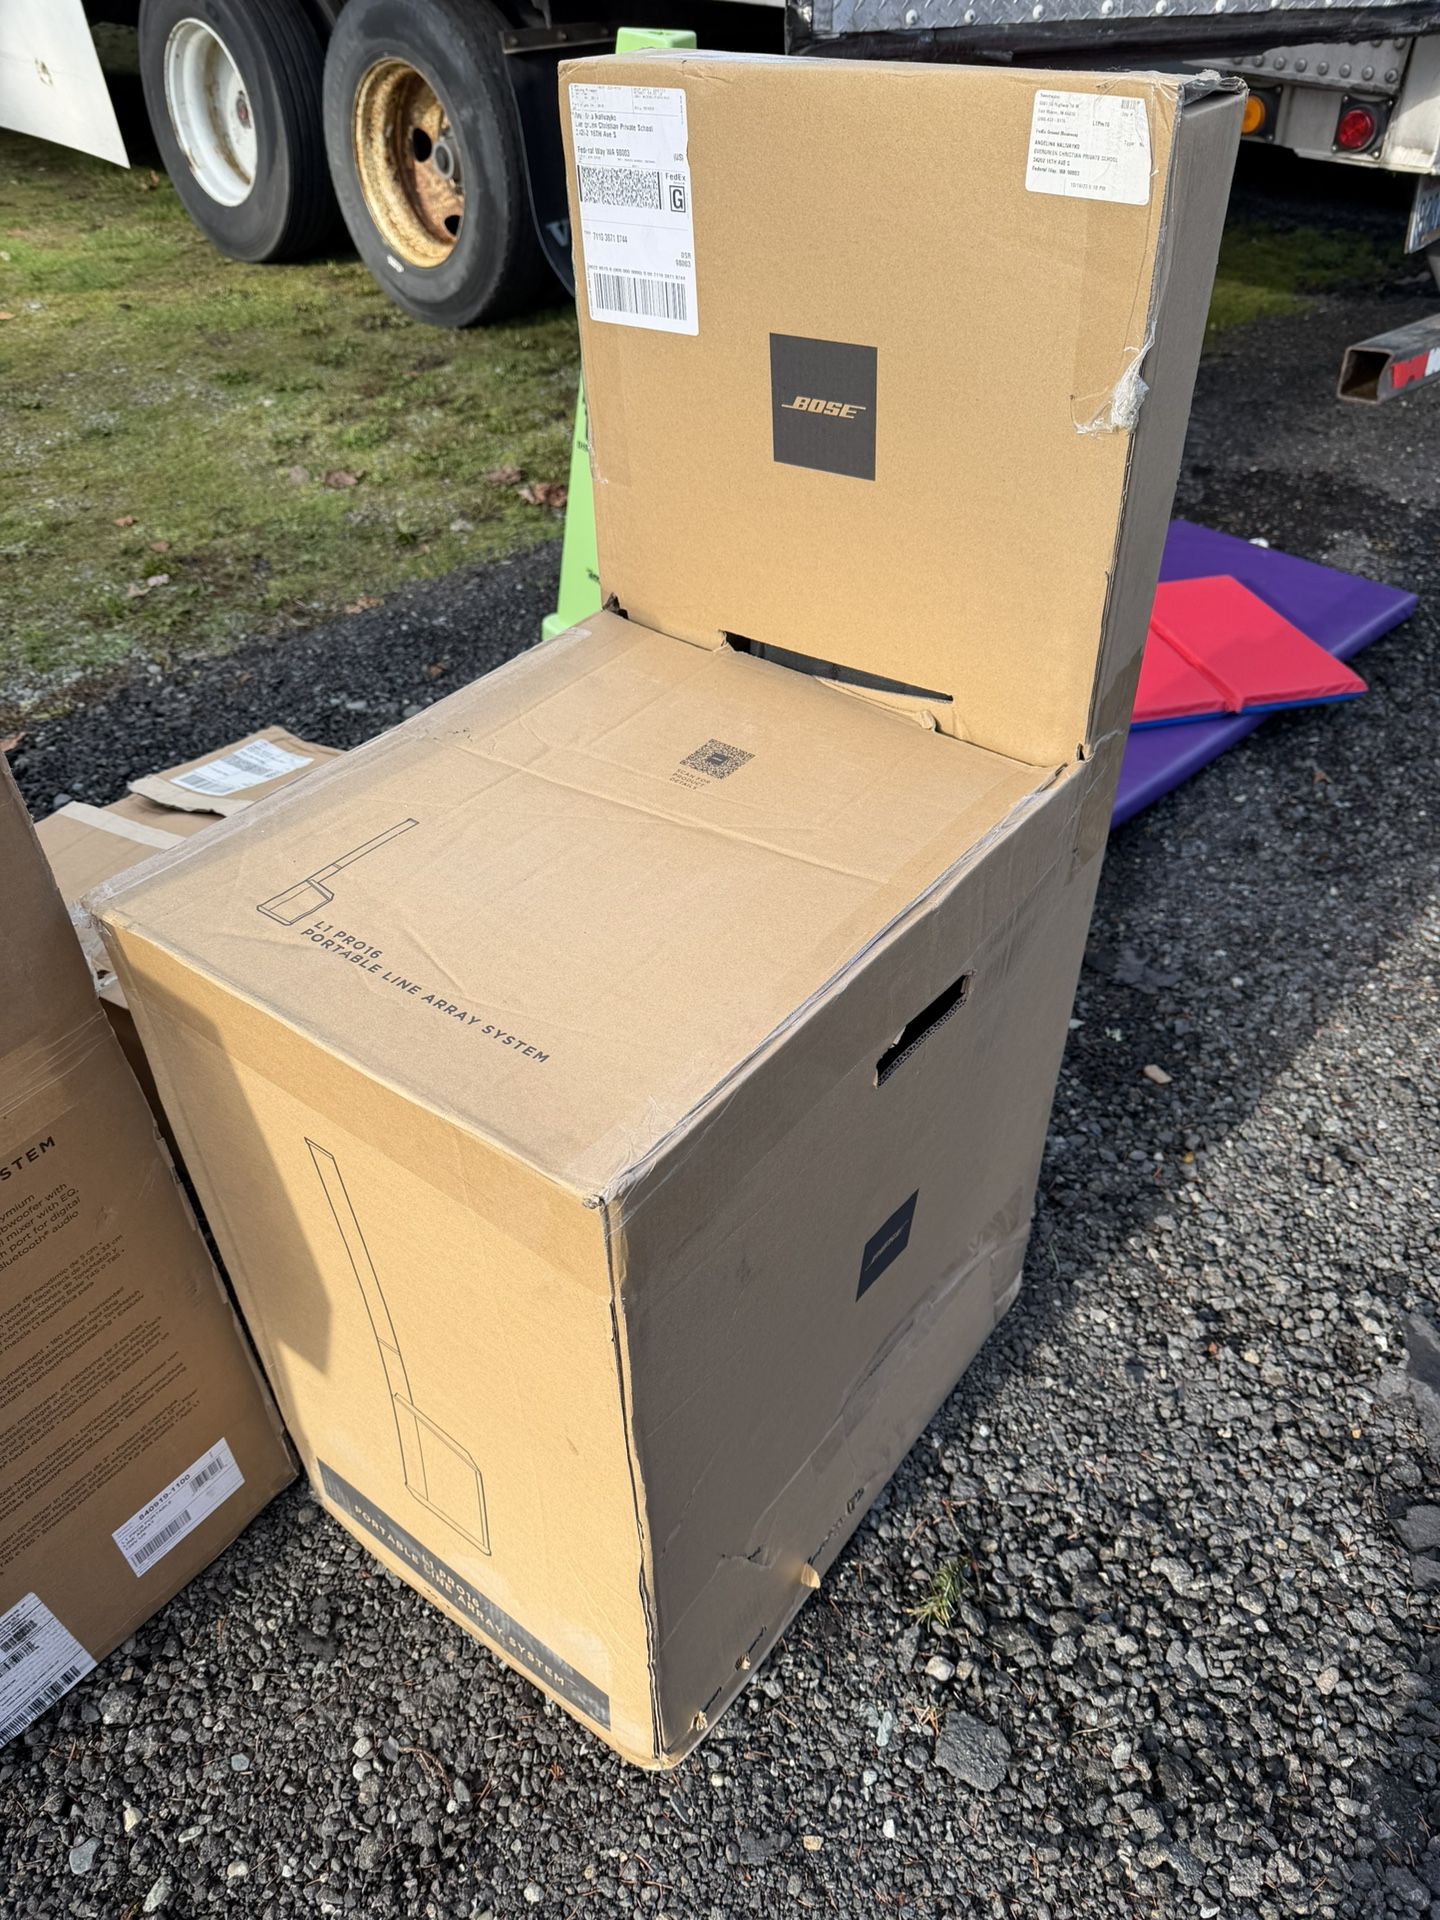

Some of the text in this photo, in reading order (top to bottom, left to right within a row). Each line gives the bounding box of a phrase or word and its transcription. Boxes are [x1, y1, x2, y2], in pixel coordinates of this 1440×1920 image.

[666, 172, 686, 182] FedEx
[672, 188, 684, 209] G
[782, 396, 866, 419] BOSE
[314, 920, 383, 959] L1 PRO16
[300, 928, 550, 1063] PORTABLE LINE ARRAY SYSTEM
[0, 1135, 56, 1181] STEM
[43, 1181, 67, 1202] with
[4, 1216, 35, 1242] mixer
[35, 1199, 59, 1220] with
[7, 1195, 82, 1253] port for digital
[50, 1209, 79, 1233] audio
[354, 1505, 419, 1566] PORTABLE
[458, 1595, 503, 1636] ARRAY
[508, 1636, 566, 1687] SYSTEM
[439, 1569, 479, 1608] PRO16
